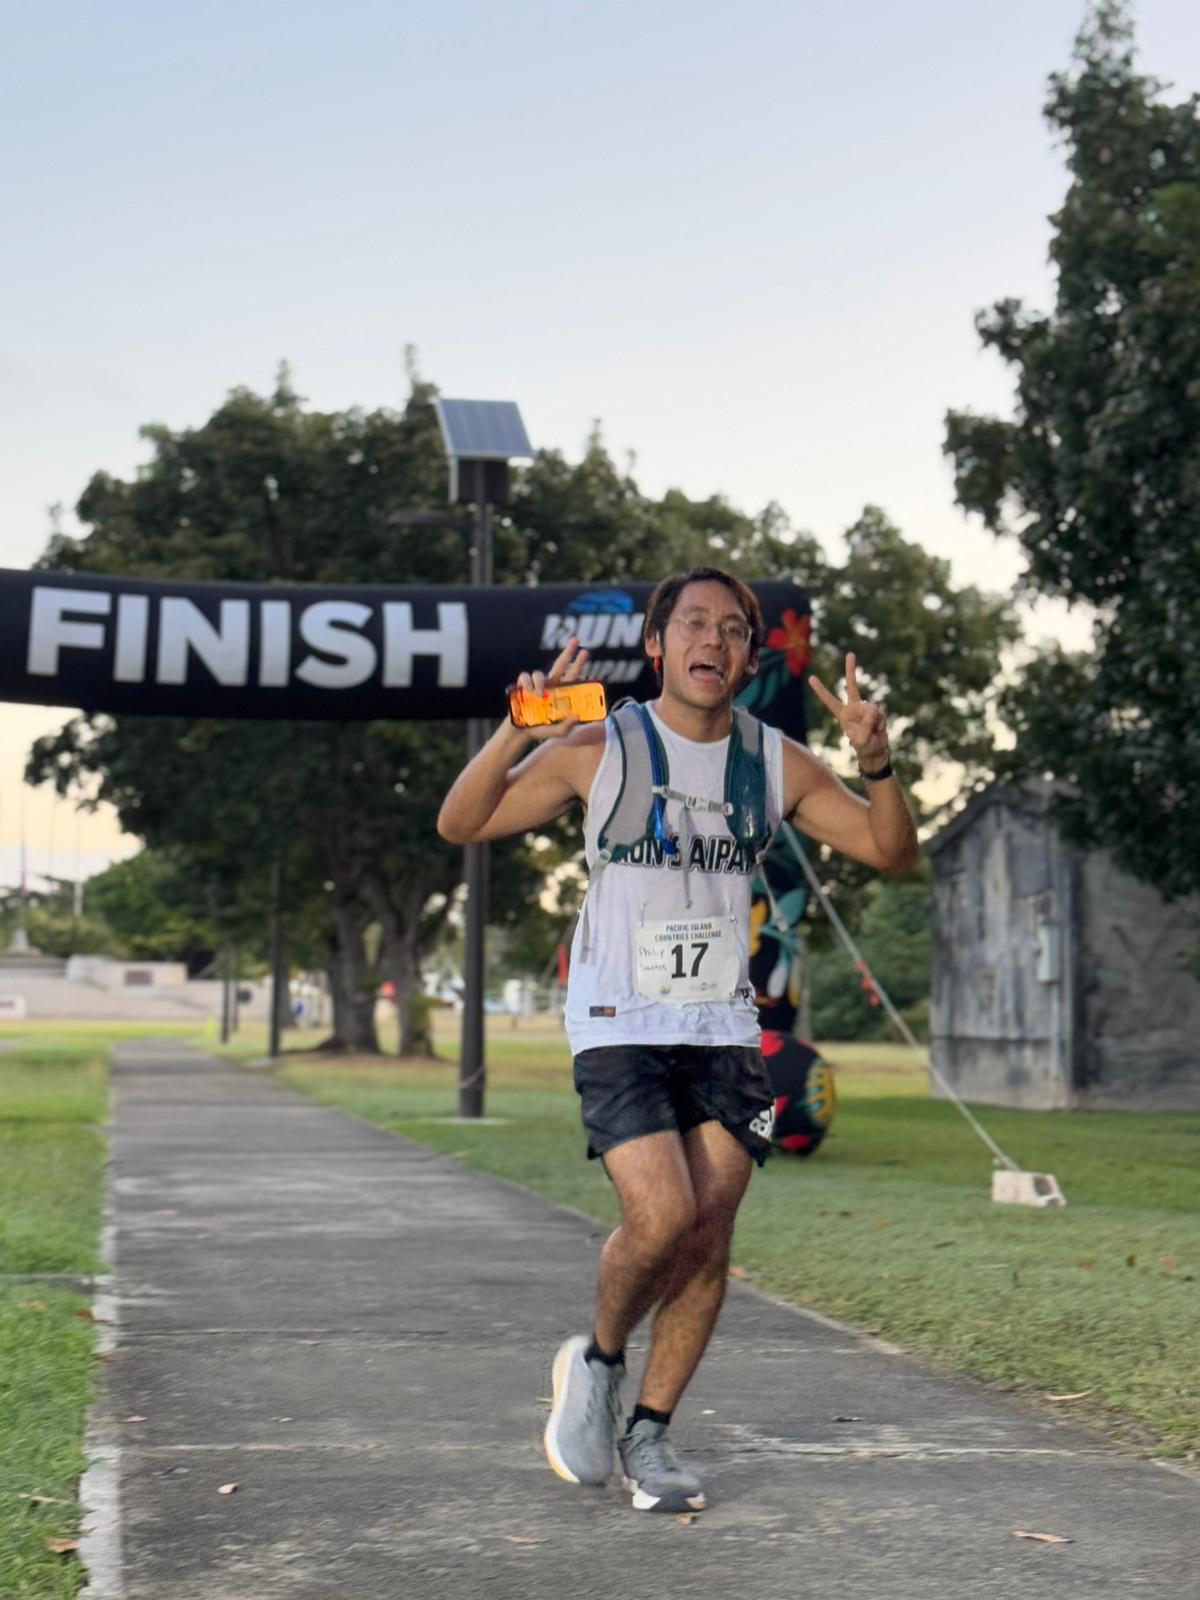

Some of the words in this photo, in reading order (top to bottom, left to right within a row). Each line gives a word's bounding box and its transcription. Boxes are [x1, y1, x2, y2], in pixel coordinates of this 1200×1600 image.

[27, 586, 469, 689] FINISH
[540, 613, 645, 650] RUN
[619, 837, 667, 868] UN
[668, 833, 753, 874] AIPA
[654, 933, 689, 942] COUNTRIES
[690, 930, 722, 940] CHALLENGE
[666, 924, 690, 933] PACIFIC
[691, 922, 713, 931] ISLAND
[671, 942, 709, 979] 17
